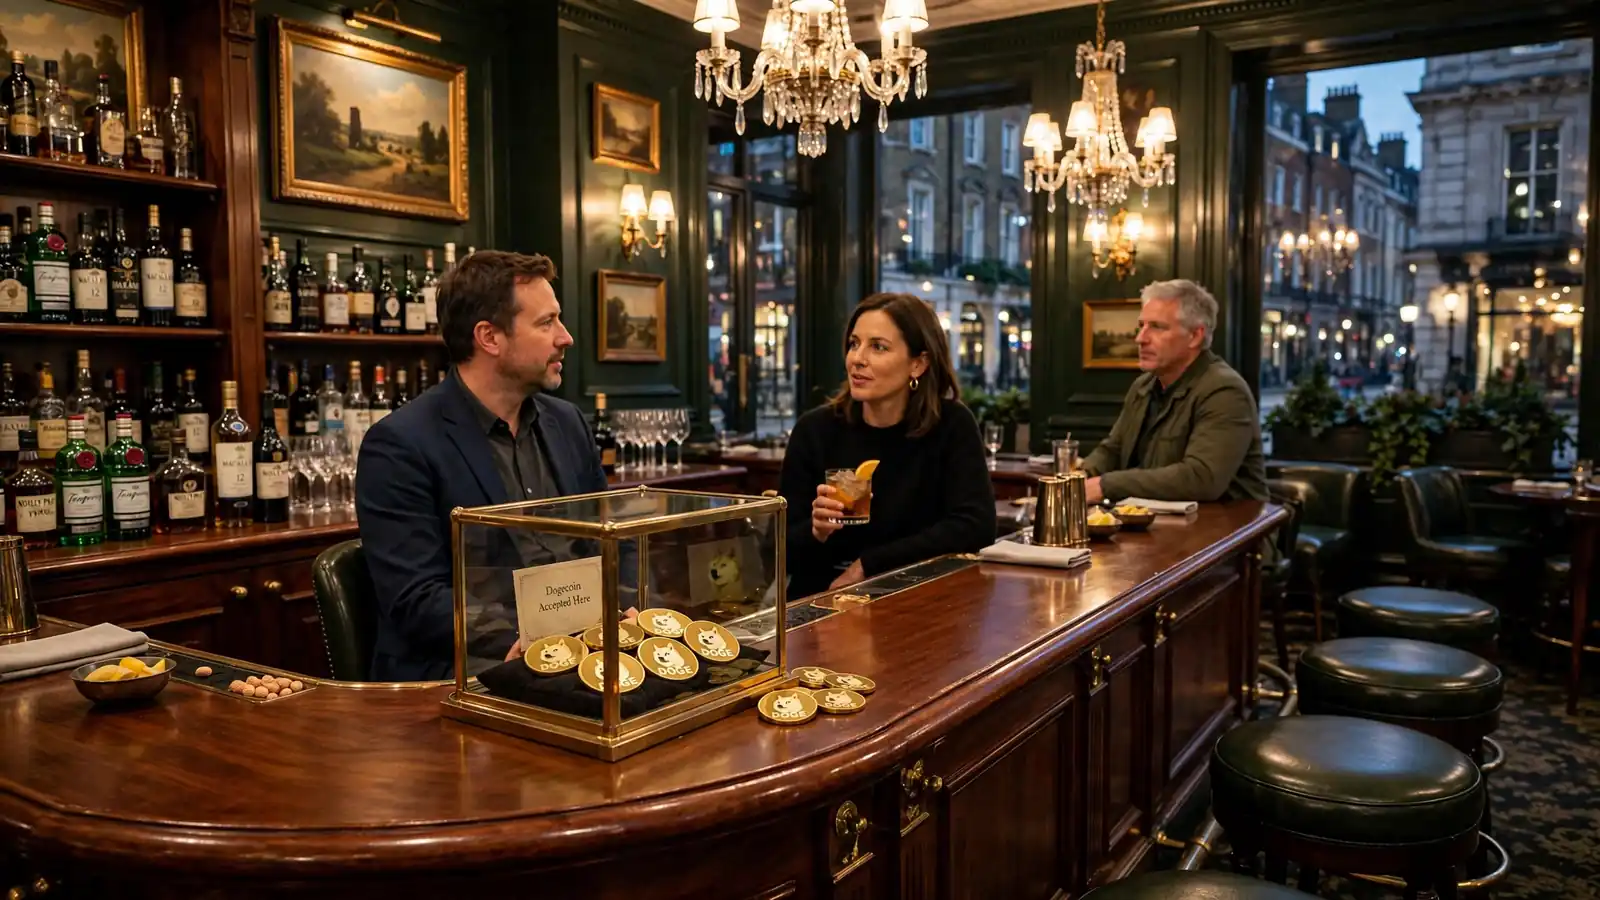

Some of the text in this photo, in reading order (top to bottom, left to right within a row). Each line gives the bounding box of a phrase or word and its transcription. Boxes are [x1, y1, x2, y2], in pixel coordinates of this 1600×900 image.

[236, 473, 245, 482] 12
[545, 581, 582, 597] Dogecoin
[538, 594, 591, 612] Accepted Here
[700, 648, 734, 657] DOGE
[540, 657, 577, 671] DOGE
[658, 665, 694, 675] DOGE
[771, 711, 807, 719] DOGE
